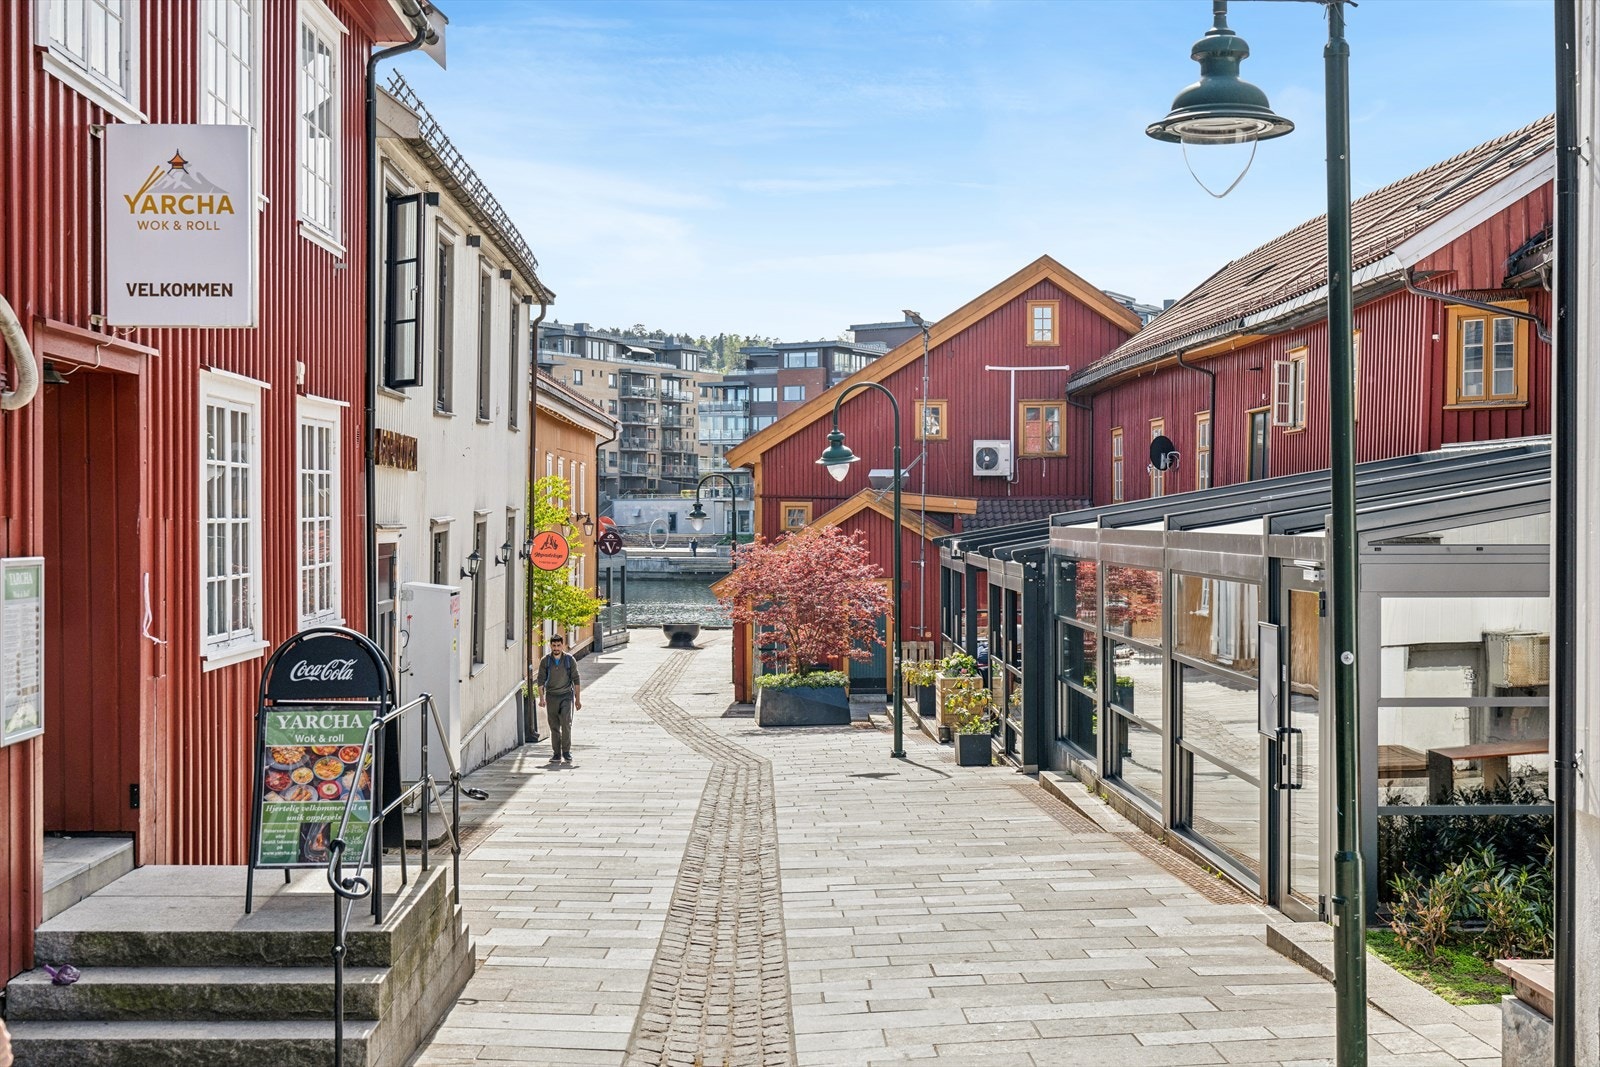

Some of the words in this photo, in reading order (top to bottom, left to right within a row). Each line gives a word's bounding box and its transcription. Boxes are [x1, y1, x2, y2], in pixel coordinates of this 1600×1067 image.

[124, 194, 235, 215] YARCHA
[137, 220, 170, 231] WOK
[173, 220, 182, 231] &
[187, 220, 221, 231] ROLL
[126, 282, 234, 298] VELKOMMEN
[290, 659, 358, 681] Coca-Cola
[277, 714, 364, 729] YARCHA
[295, 734, 315, 744] Wok
[318, 734, 326, 743] &
[328, 734, 345, 743] roll
[286, 813, 304, 821] unik
[305, 813, 343, 823] opplevels
